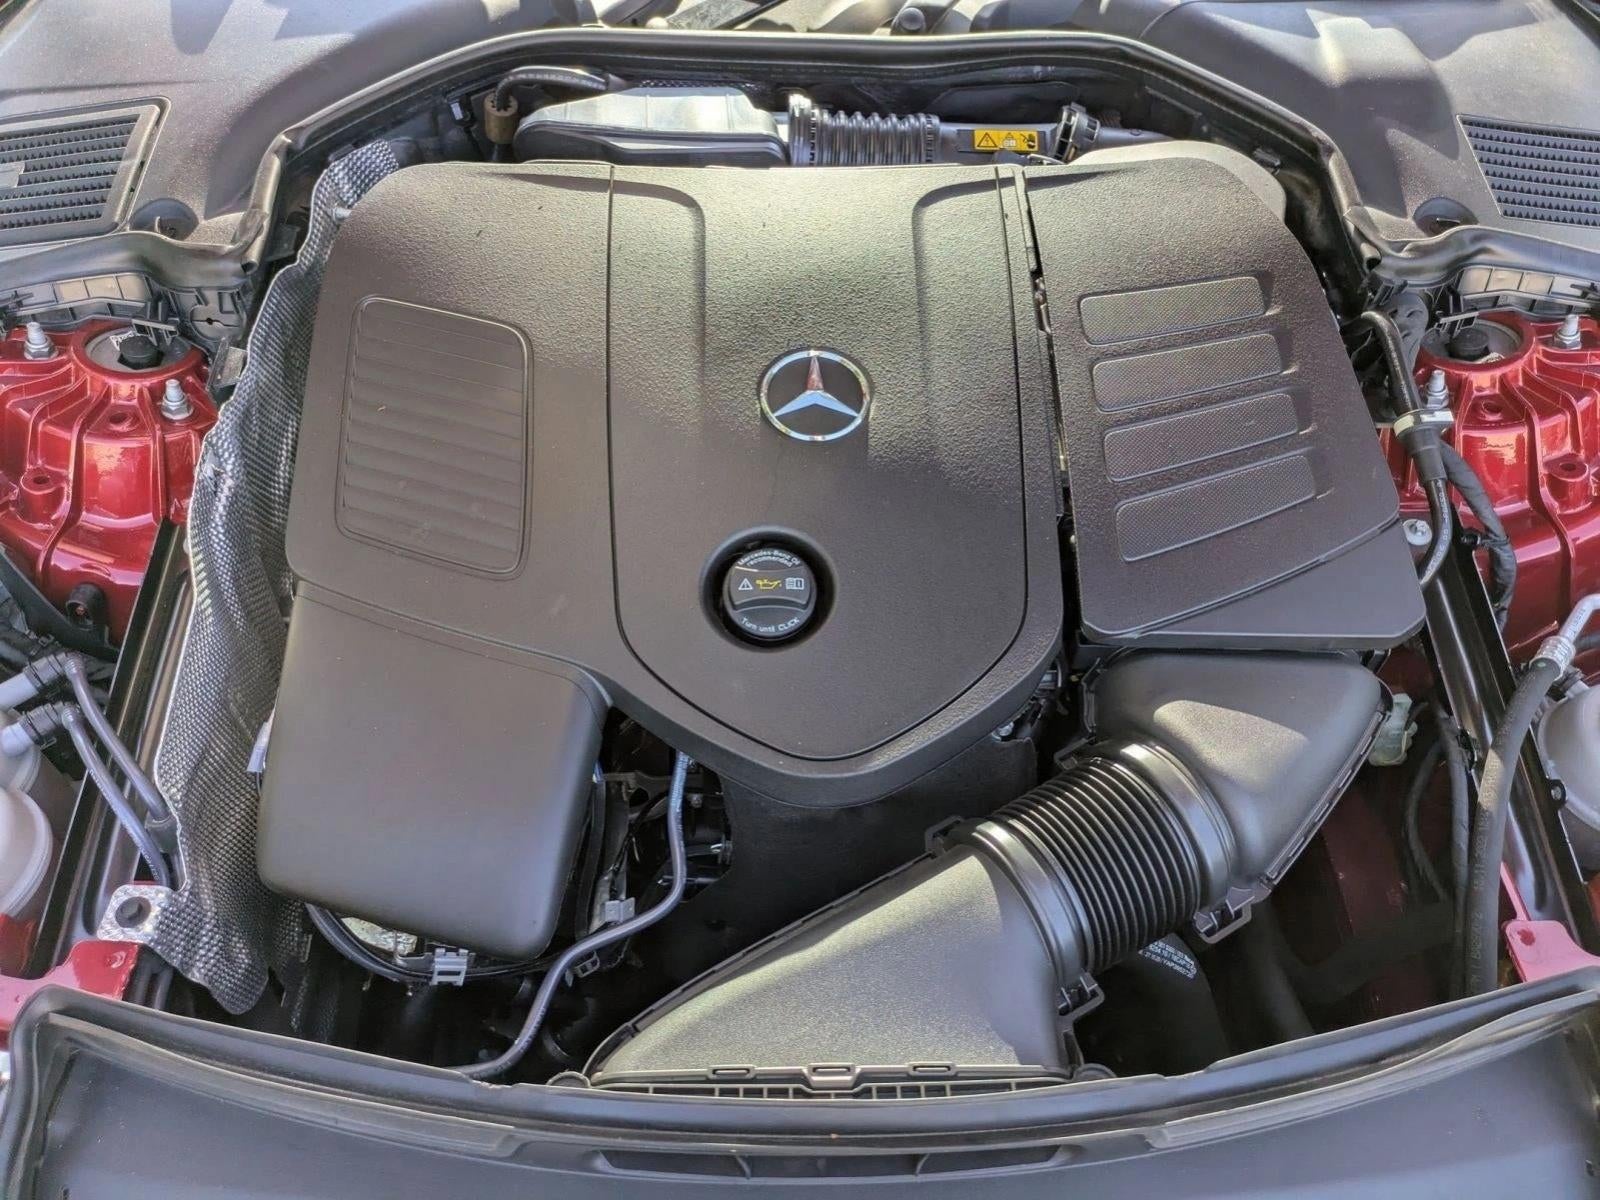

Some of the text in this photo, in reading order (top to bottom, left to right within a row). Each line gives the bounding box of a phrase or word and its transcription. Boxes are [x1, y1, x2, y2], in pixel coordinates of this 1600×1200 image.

[737, 550, 791, 565] Mercedes-Benz
[746, 556, 793, 567] recommended
[742, 617, 758, 630] Turn
[778, 617, 800, 631] CLICK
